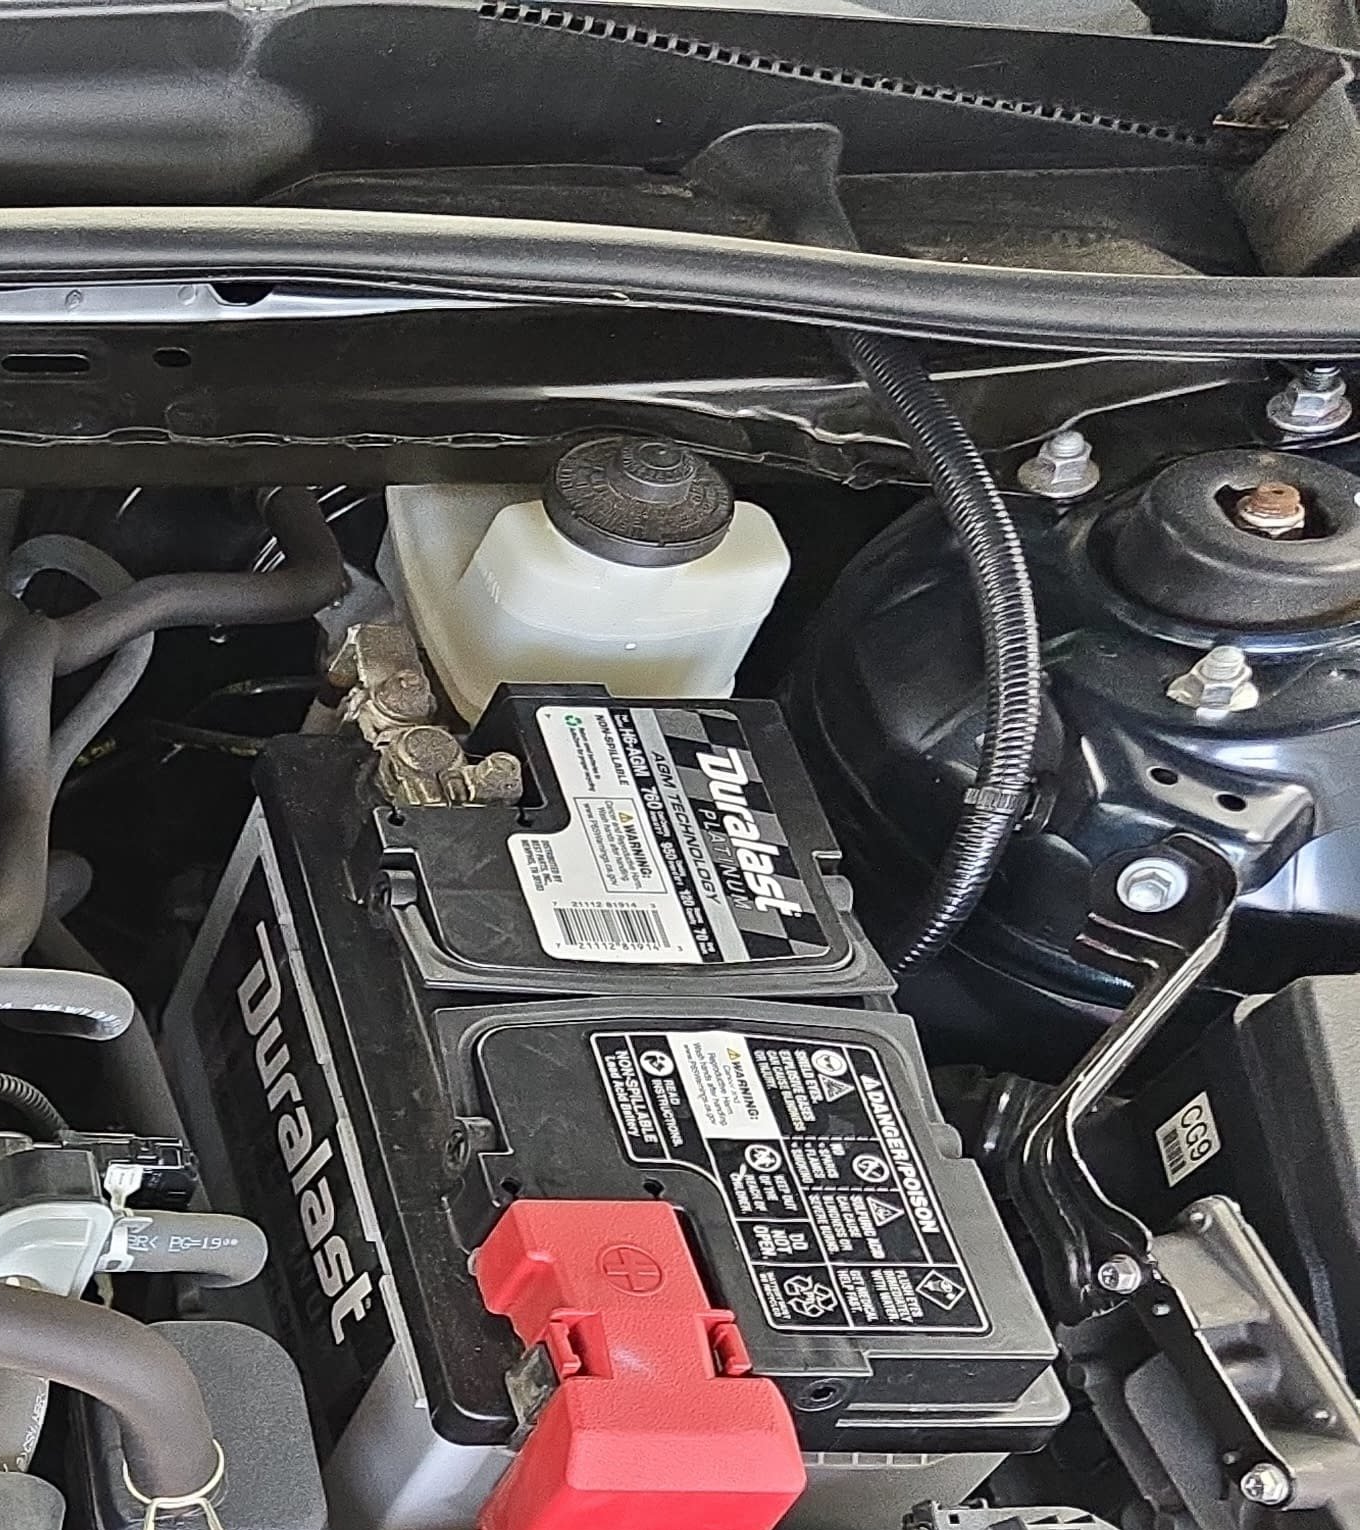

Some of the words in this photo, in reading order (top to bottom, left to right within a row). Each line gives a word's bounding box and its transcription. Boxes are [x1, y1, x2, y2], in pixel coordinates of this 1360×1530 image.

[594, 714, 630, 785] NON-SPILLABLE
[596, 806, 610, 822] Wash
[604, 800, 619, 821] Cancer
[602, 824, 616, 840] hands
[612, 822, 623, 833] and
[617, 728, 651, 776] H6-AGM
[638, 786, 663, 809] 760
[658, 841, 679, 860] 950
[676, 889, 696, 905] 120
[691, 928, 709, 941] 70
[650, 751, 677, 788] AGM
[666, 794, 721, 904] TECHNOLOGY
[692, 747, 804, 916] Duralast
[609, 843, 622, 855] after
[615, 834, 637, 870] Reproductive
[622, 825, 654, 878] WARNING:
[697, 808, 753, 910] PLATINUM
[579, 941, 619, 951] 21112
[620, 941, 660, 951] 81914
[691, 1042, 706, 1060] Wash
[752, 1049, 766, 1061] OR
[765, 1049, 782, 1065] CAN
[791, 1049, 815, 1078] SHIELD
[602, 1054, 622, 1078] Lead
[697, 1061, 713, 1080] hands
[703, 1052, 730, 1093] Reproductive
[771, 1066, 791, 1089] CAUSE
[611, 1080, 630, 1101] Acid
[612, 1049, 660, 1142] NON-SPILLABLE
[662, 1079, 683, 1105] READ
[705, 1082, 719, 1096] after
[728, 1061, 762, 1120] WARNING:
[776, 1049, 807, 1094] EXPLOSIVE
[794, 1094, 817, 1121] GASES
[617, 1103, 642, 1136] Battery
[649, 1079, 685, 1147] INSTRUCTIONS.
[779, 1090, 807, 1131] BLINDNESS
[237, 920, 373, 1345] Duralast
[1180, 1105, 1213, 1161] CG9
[828, 1143, 846, 1155] NO
[864, 1089, 941, 1232] DANGER/POISON
[789, 1149, 814, 1183] SMOKING
[803, 1148, 826, 1178] FLAMES
[817, 1148, 841, 1178] SPARKS
[742, 1174, 763, 1199] REACH
[757, 1174, 773, 1185] OF
[772, 1174, 791, 1193] KEEP
[752, 1200, 768, 1211] OF
[761, 1186, 779, 1200] THE
[779, 1195, 798, 1211] OUT
[835, 1195, 852, 1211] CAN
[806, 1193, 829, 1223] SEVERE
[820, 1195, 849, 1237] BLINDNESS
[837, 1238, 854, 1250] OR
[841, 1213, 863, 1238] CAUSE
[848, 1194, 878, 1236] SULFURIC
[865, 1238, 887, 1258] ACID
[750, 1224, 780, 1259] OPEN.
[768, 1229, 794, 1254] NOT
[786, 1232, 810, 1250] DO
[835, 1270, 855, 1290] HELP
[848, 1270, 865, 1285] GET
[868, 1269, 889, 1290] WITH
[843, 1292, 863, 1313] FAST.
[854, 1286, 879, 1321] MEDICAL
[881, 1269, 914, 1322] IMMEDIATELY
[893, 1269, 915, 1295] FLUSH
[904, 1297, 924, 1317] EYES
[877, 1292, 901, 1321] WATER.
